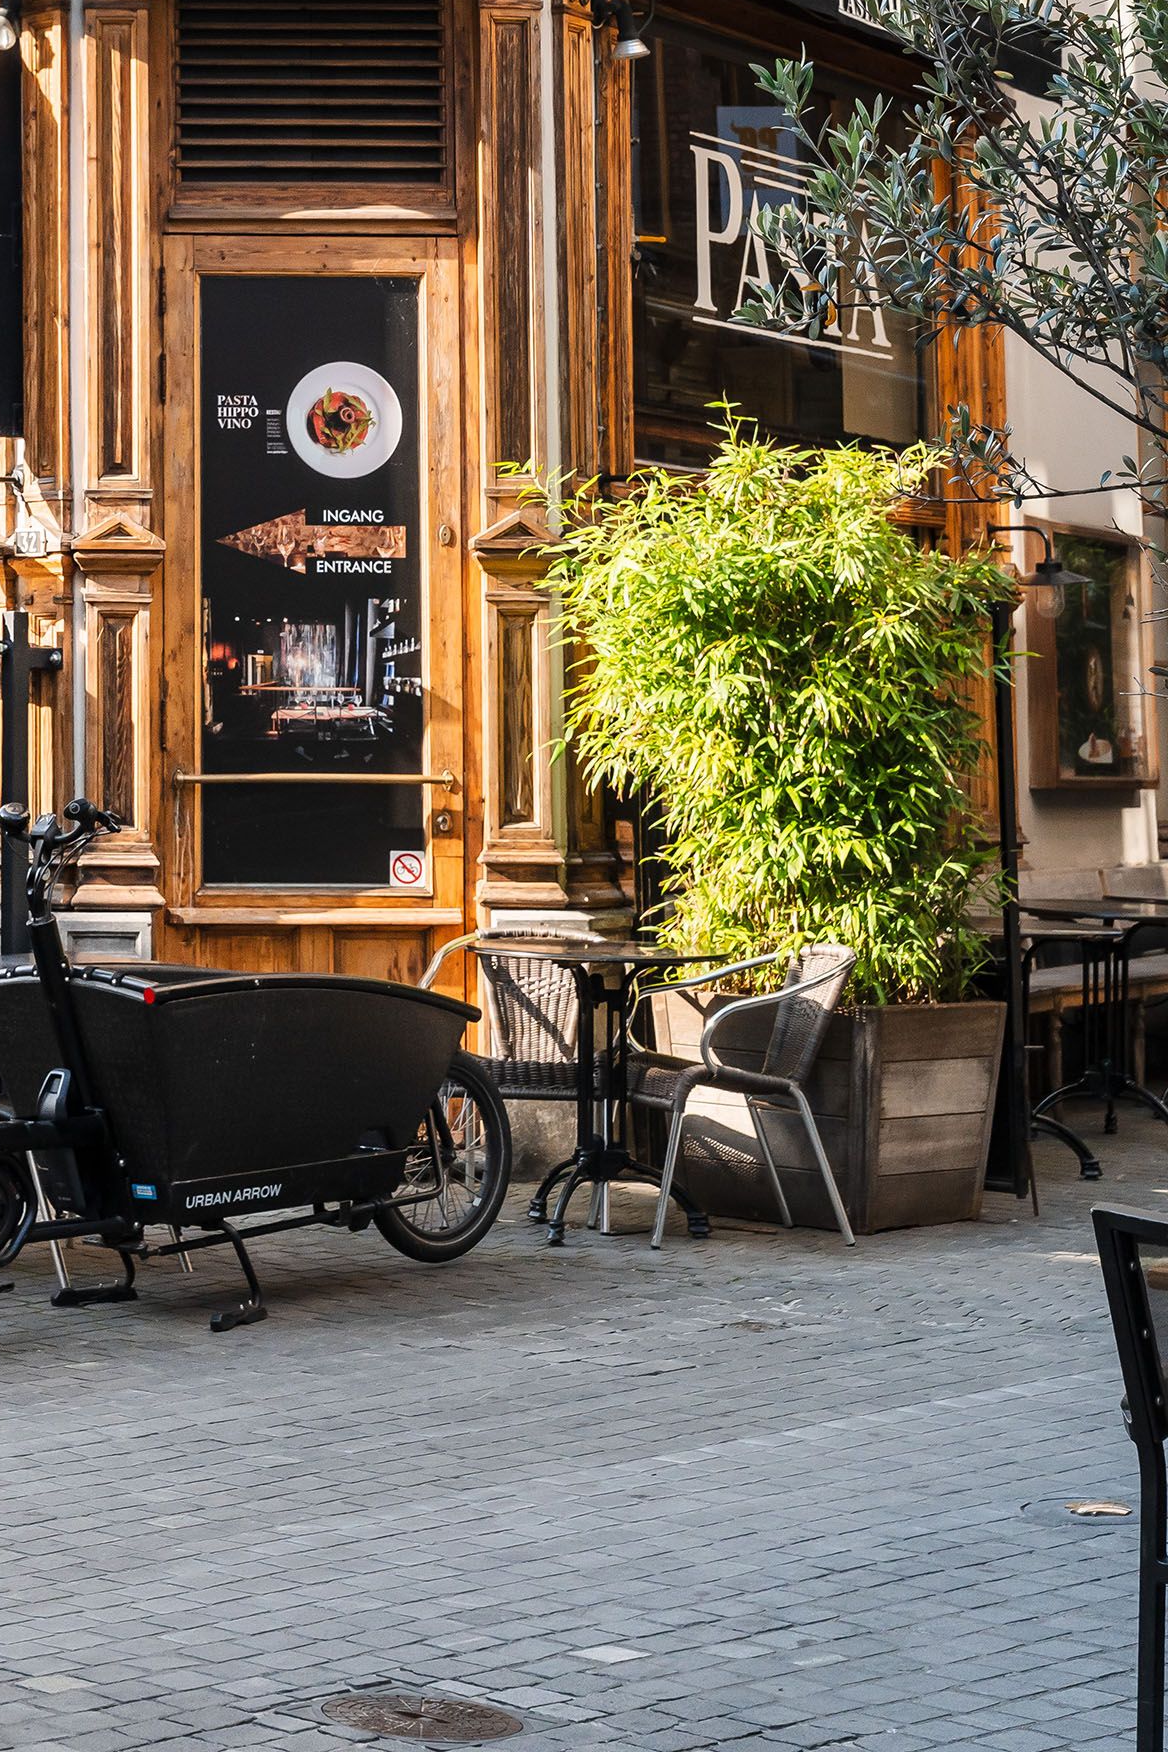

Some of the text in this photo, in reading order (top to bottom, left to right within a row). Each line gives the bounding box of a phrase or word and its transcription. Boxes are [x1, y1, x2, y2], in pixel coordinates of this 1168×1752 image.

[217, 395, 258, 406] PASTA
[217, 406, 259, 418] HIPPO
[217, 418, 252, 429] VINO
[323, 509, 384, 523] INGANG
[20, 532, 37, 553] 32
[316, 560, 392, 574] ENTRANCE
[185, 1183, 282, 1209] URBAN ARROW
